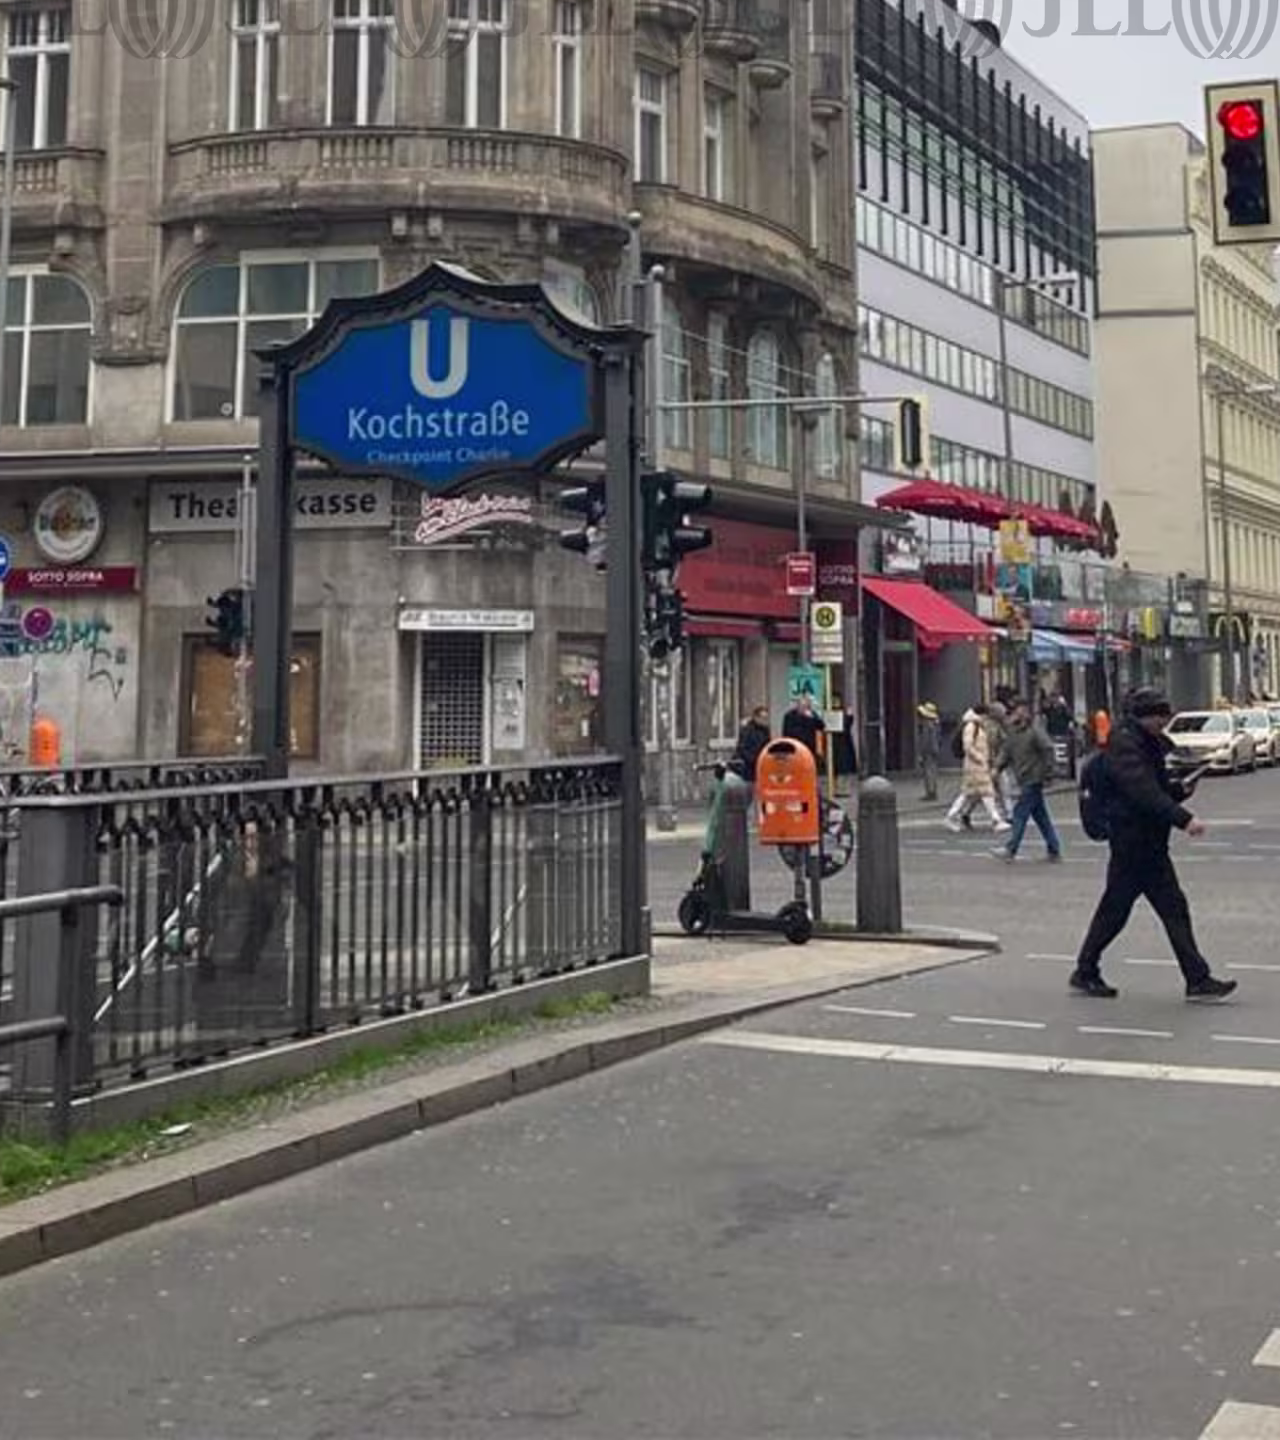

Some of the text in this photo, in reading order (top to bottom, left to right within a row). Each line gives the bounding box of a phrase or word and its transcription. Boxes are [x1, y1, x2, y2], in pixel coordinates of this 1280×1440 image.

[410, 318, 469, 399] U
[347, 399, 530, 441] Kochstraße
[366, 447, 512, 465] Checkpoint Charlie
[168, 490, 378, 519] Theakasse
[27, 570, 104, 583] SOTTO SOPRA
[791, 677, 815, 695] JA
